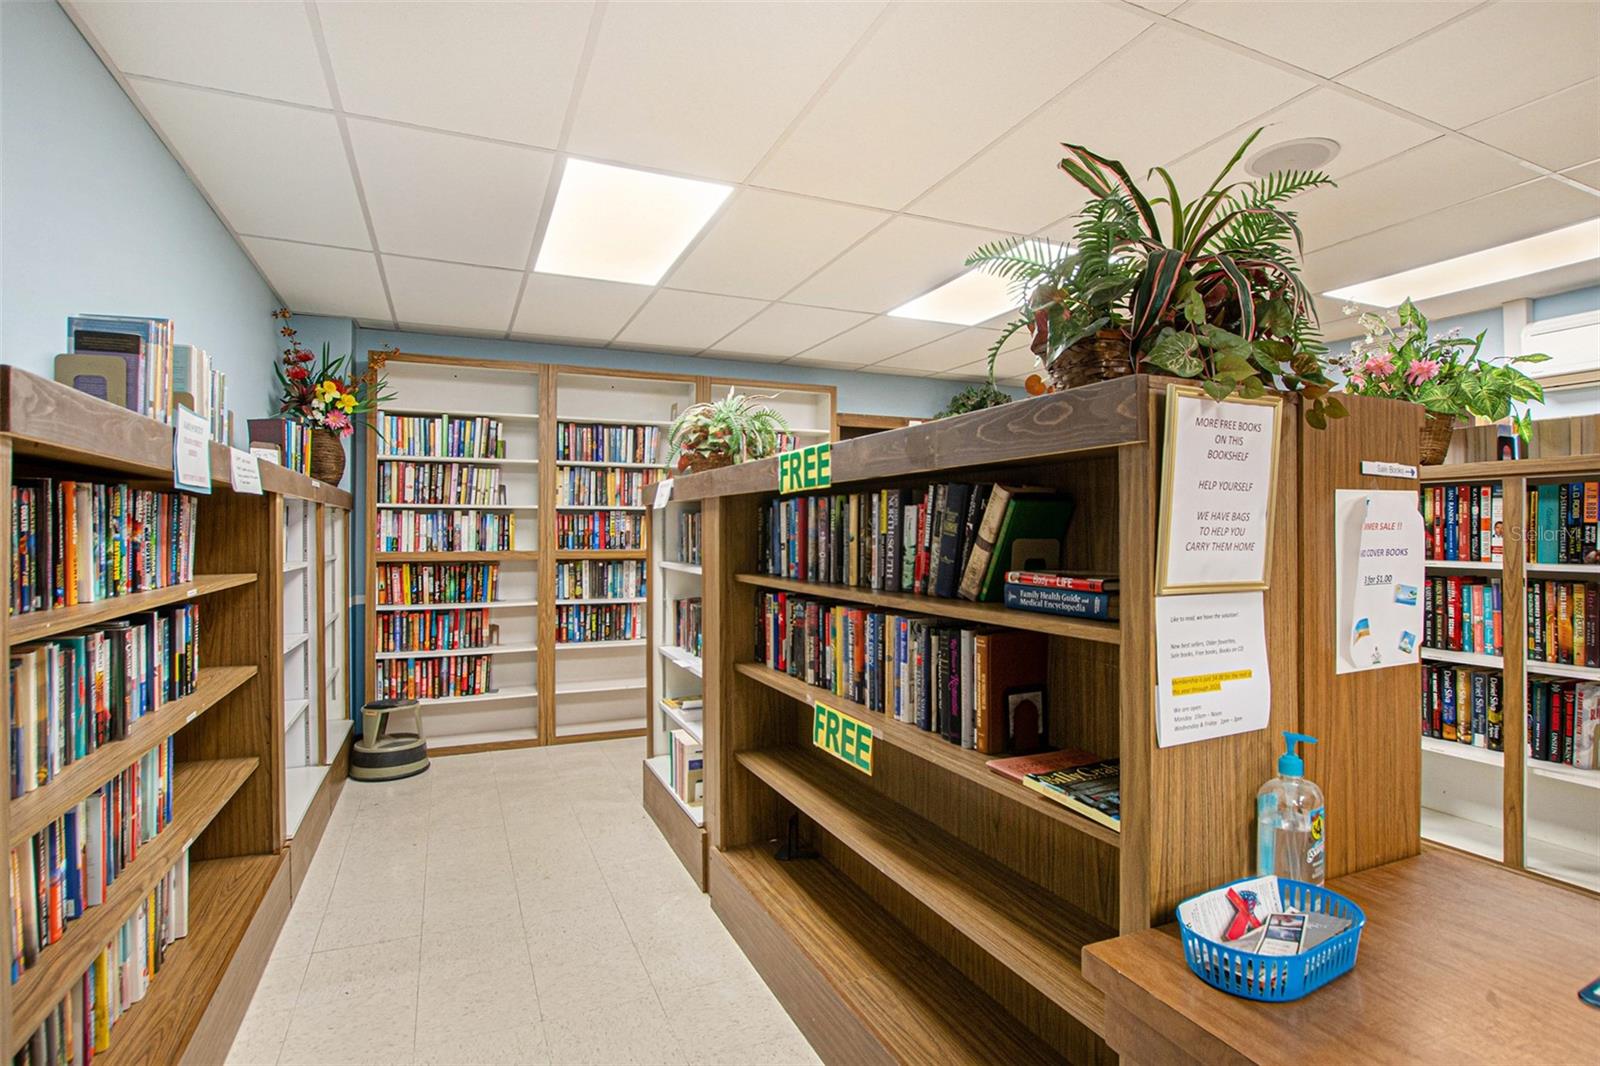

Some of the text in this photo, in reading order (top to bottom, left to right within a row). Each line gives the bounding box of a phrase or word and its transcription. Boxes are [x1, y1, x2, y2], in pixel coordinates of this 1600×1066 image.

[1195, 417, 1262, 432] MORE FREE BOOKS
[1215, 435, 1244, 446] ON THIS
[1207, 449, 1249, 461] BOOKSHELF
[780, 444, 831, 492] FREE
[1198, 480, 1253, 492] HELP YOURSELF
[924, 485, 934, 547] JONATHAN KELLERMAN
[1572, 499, 1580, 519] ROBB
[1586, 502, 1597, 519] ROBB
[20, 505, 29, 532] COULTER
[1197, 511, 1250, 522] WE HAVE BAGS
[1199, 526, 1246, 537] TO HELP YOU
[1380, 522, 1396, 530] SALE
[886, 496, 895, 578] NORTH SOUTH
[1185, 542, 1255, 551] CARRY THEM HOME
[1367, 549, 1384, 557] COVER
[1386, 548, 1408, 556] BOOKS
[1032, 575, 1073, 588] Body LIFE
[1376, 574, 1392, 583] $1.00
[1020, 590, 1039, 600] Family
[1040, 591, 1061, 600] Health
[1062, 594, 1081, 603] Guide
[1020, 599, 1043, 607] Medical
[1044, 600, 1086, 612] Encyclopedia
[1576, 598, 1584, 638] HARRY POTTER
[1444, 670, 1452, 703] Daniel Silva
[1475, 677, 1483, 713] Daniel Silva
[1490, 697, 1498, 712] Silva
[814, 702, 873, 773] FREE
